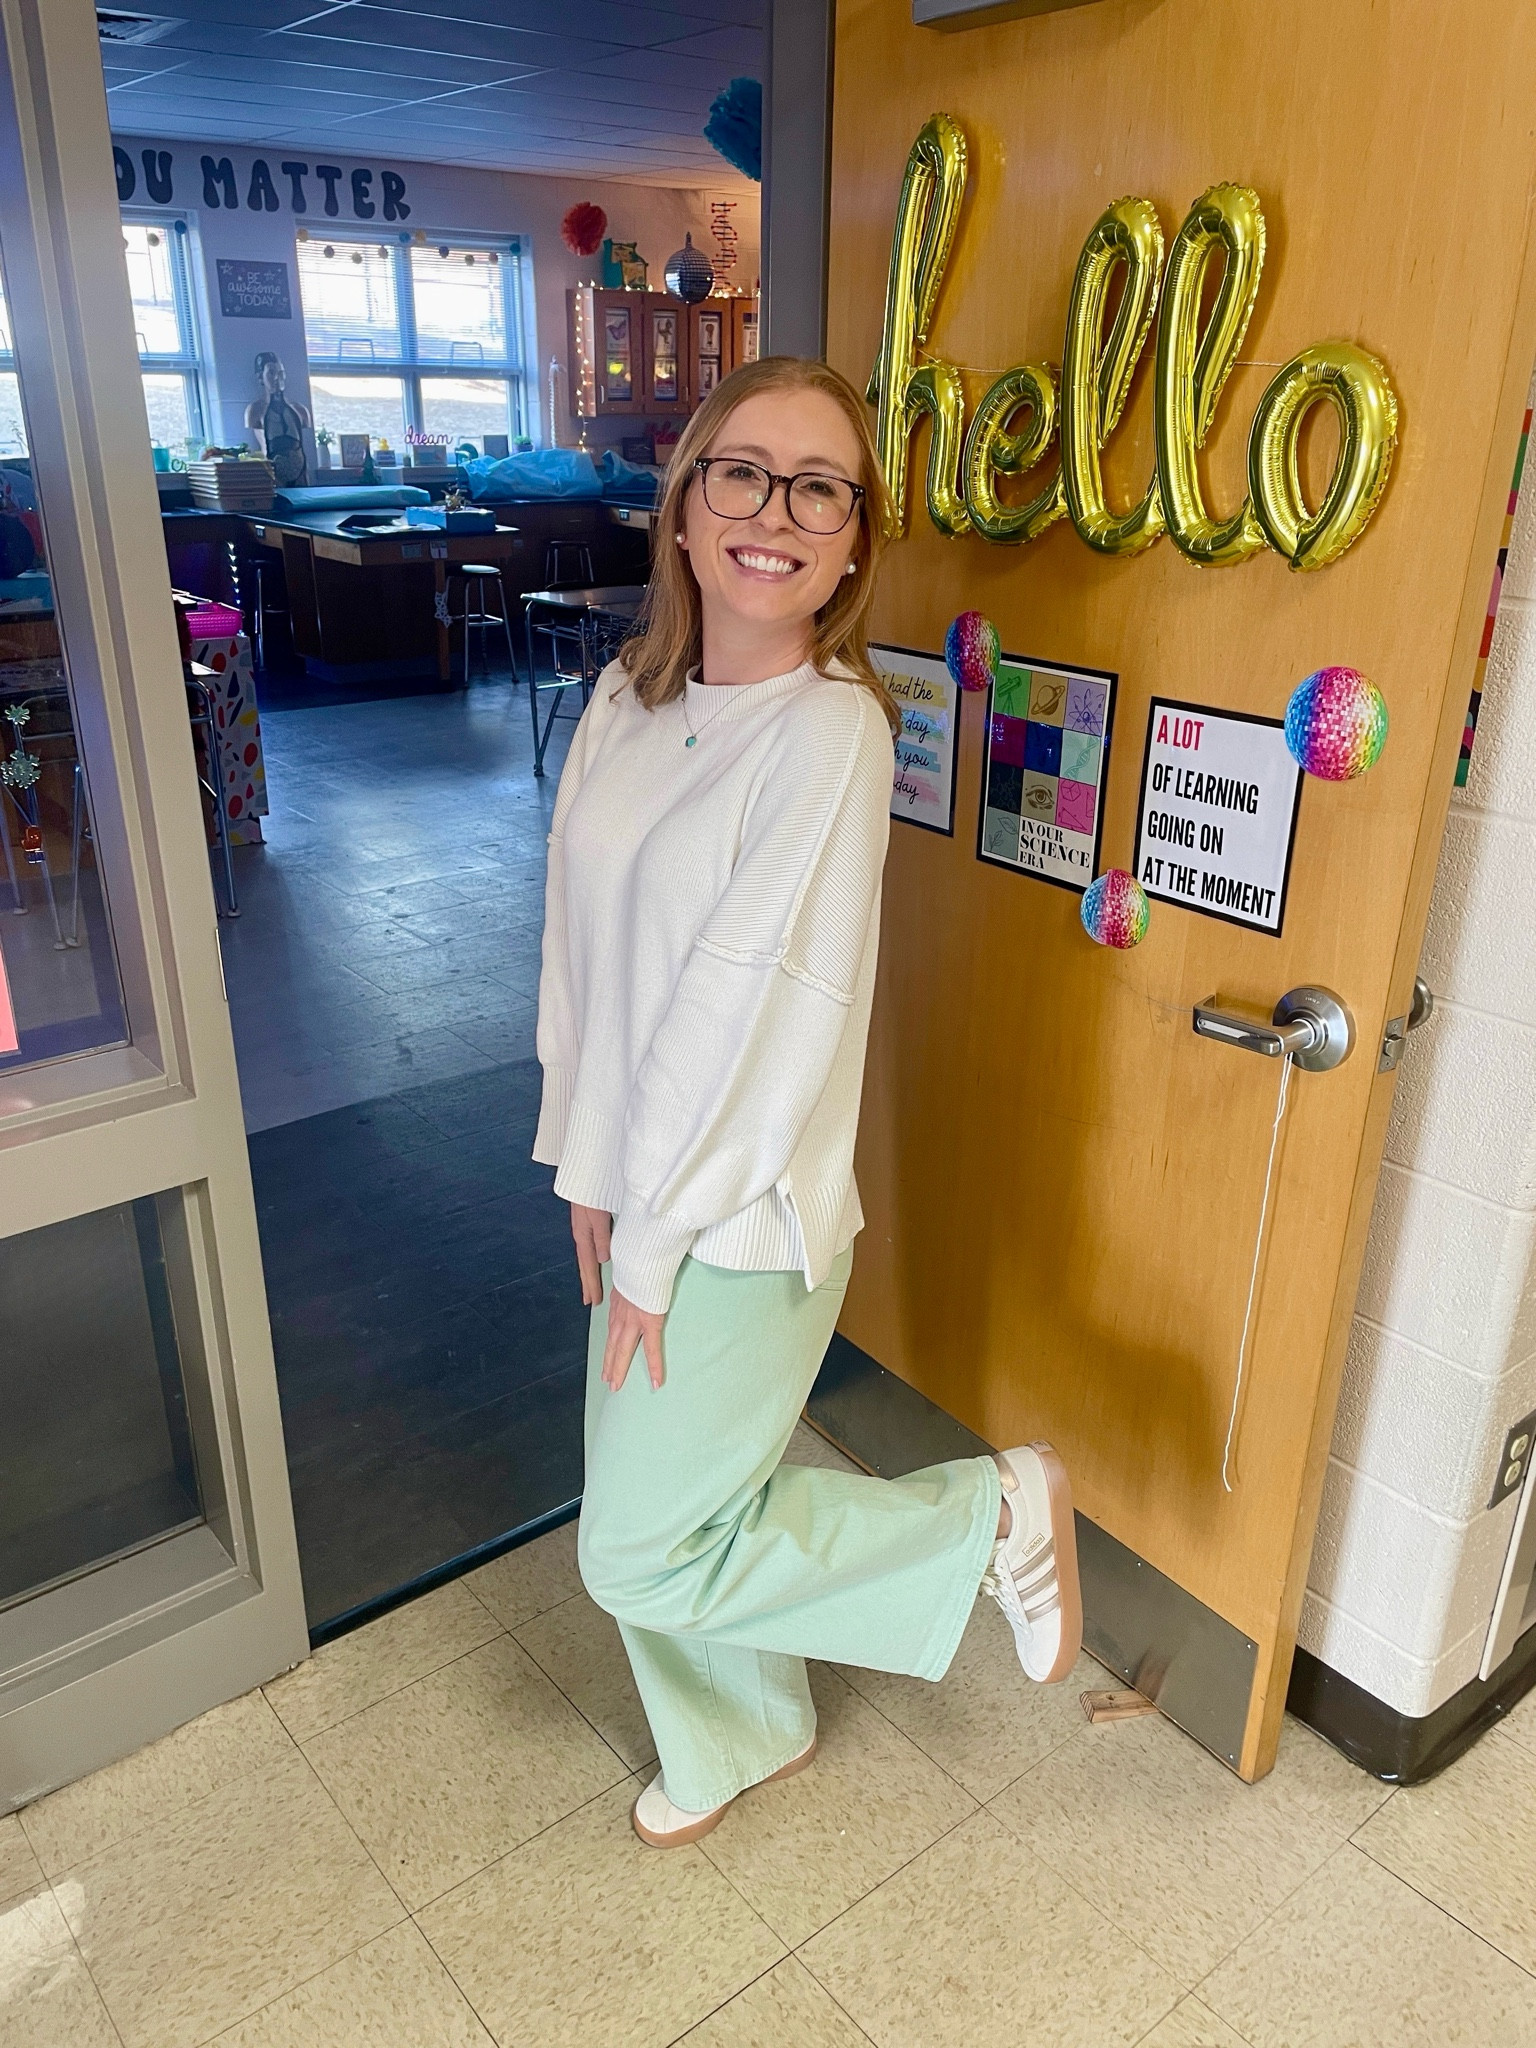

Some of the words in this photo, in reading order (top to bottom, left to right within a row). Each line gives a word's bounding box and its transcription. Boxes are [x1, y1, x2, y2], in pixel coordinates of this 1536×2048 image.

[113, 146, 173, 204] OU
[200, 155, 411, 221] MATTER
[247, 271, 261, 284] BE
[237, 293, 275, 306] TODAY
[866, 112, 1398, 572] hello
[404, 424, 453, 445] dream
[888, 673, 913, 699] had
[913, 677, 934, 701] the
[905, 711, 930, 743] day
[1156, 714, 1168, 744] A
[1173, 717, 1204, 751] LOT
[903, 753, 930, 772] you
[893, 773, 919, 804] day
[1152, 763, 1173, 793] OF
[1175, 768, 1259, 815] LEARNING
[1021, 819, 1035, 834] IN
[1037, 824, 1063, 843] OUR
[1147, 810, 1196, 849] GOING
[1199, 823, 1224, 856] ON
[1019, 850, 1045, 870] ERA
[1020, 834, 1090, 868] SCIENCE
[1142, 856, 1164, 886] AT
[1168, 862, 1198, 897] THE
[1201, 871, 1276, 919] MOMENT
[1024, 1534, 1044, 1556] adidas
